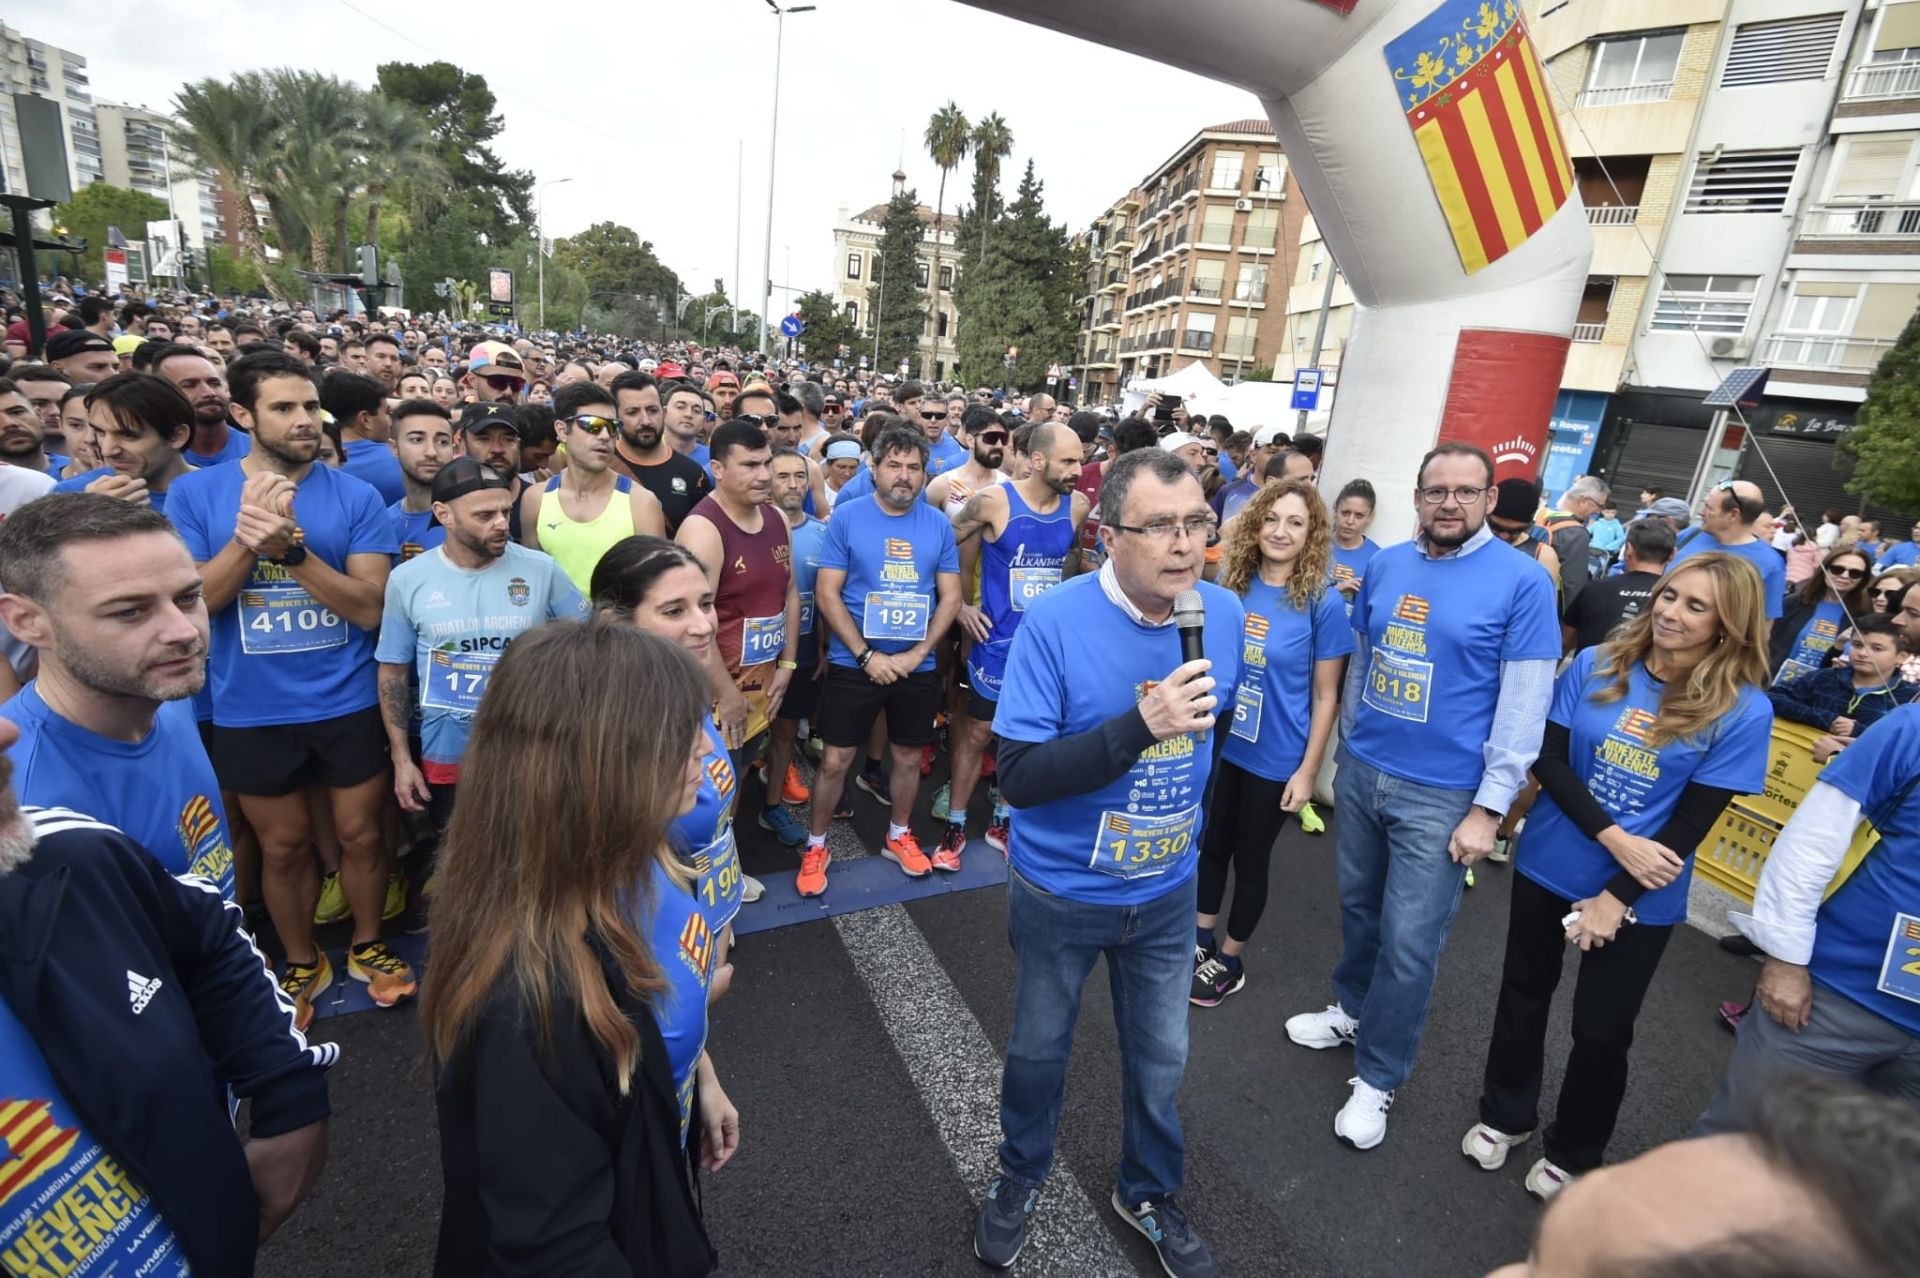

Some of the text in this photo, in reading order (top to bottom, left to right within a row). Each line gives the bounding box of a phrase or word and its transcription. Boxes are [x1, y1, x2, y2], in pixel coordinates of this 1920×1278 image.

[1559, 420, 1590, 432] Roque
[251, 608, 339, 633] 4106
[879, 608, 917, 625] 192
[446, 672, 493, 693] 17
[1371, 669, 1422, 702] 1818
[1235, 703, 1247, 721] 5
[1604, 749, 1660, 779] VALENCIA
[1109, 832, 1188, 862] 1330
[132, 977, 163, 1015] adidas
[38, 1173, 72, 1205] MARCHA
[114, 1216, 132, 1238] POR
[131, 1206, 143, 1221] LA
